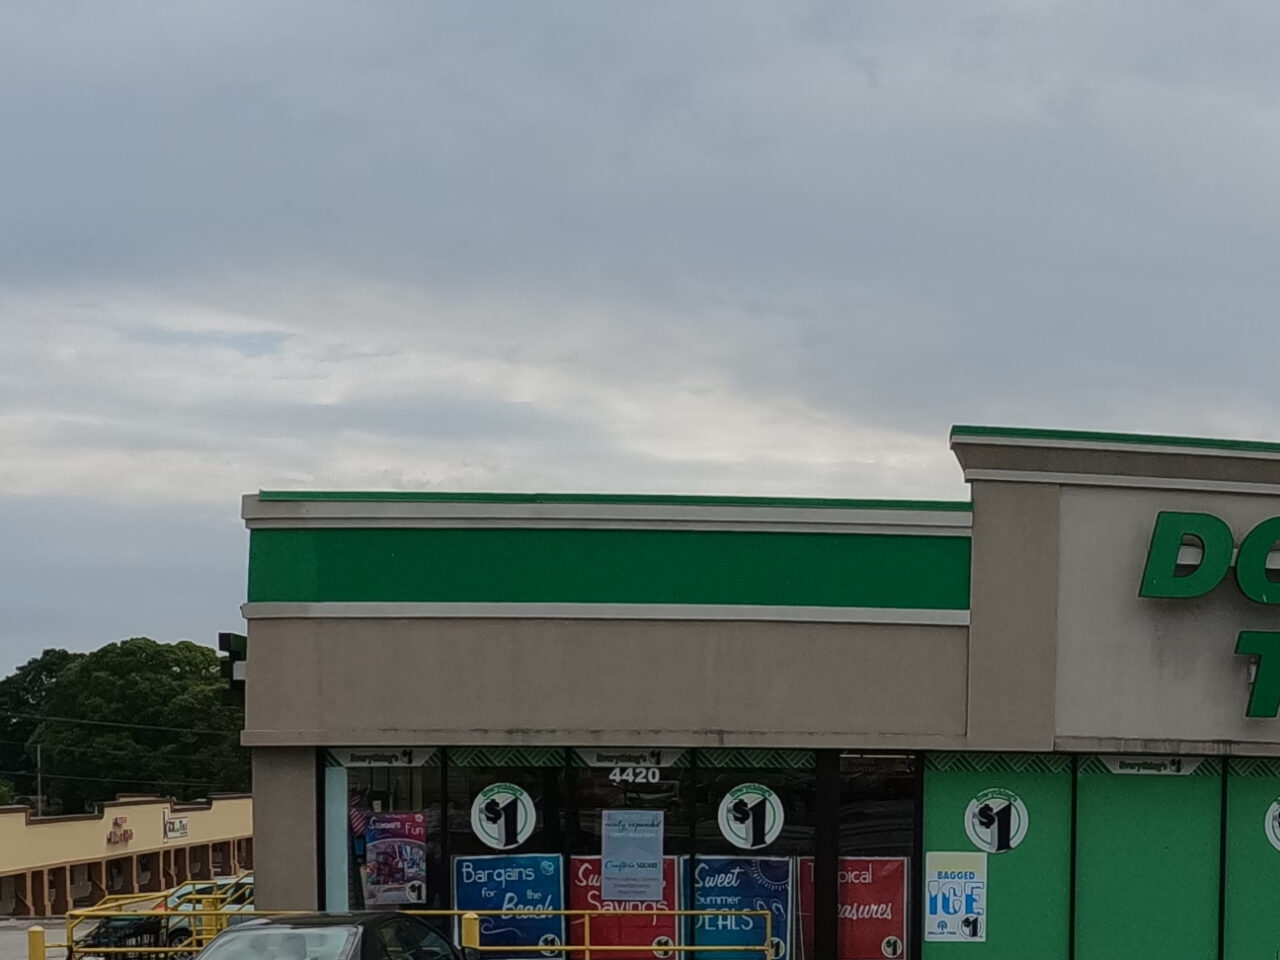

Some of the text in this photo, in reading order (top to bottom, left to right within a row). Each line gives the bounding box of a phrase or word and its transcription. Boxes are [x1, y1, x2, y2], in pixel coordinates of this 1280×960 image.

[608, 767, 660, 783] 4420
[405, 822, 424, 835] Fun
[484, 796, 520, 847] $1
[732, 797, 767, 847] $1
[978, 802, 1012, 852] $1
[462, 861, 535, 888] Bargains
[694, 862, 745, 888] Sweet
[936, 871, 976, 880] BAGGED
[481, 887, 542, 900] for the
[501, 892, 554, 920] Beach
[694, 890, 742, 905] Summer
[927, 880, 985, 916] ICE
[587, 890, 669, 926] Savings
[696, 908, 754, 931] EALS
